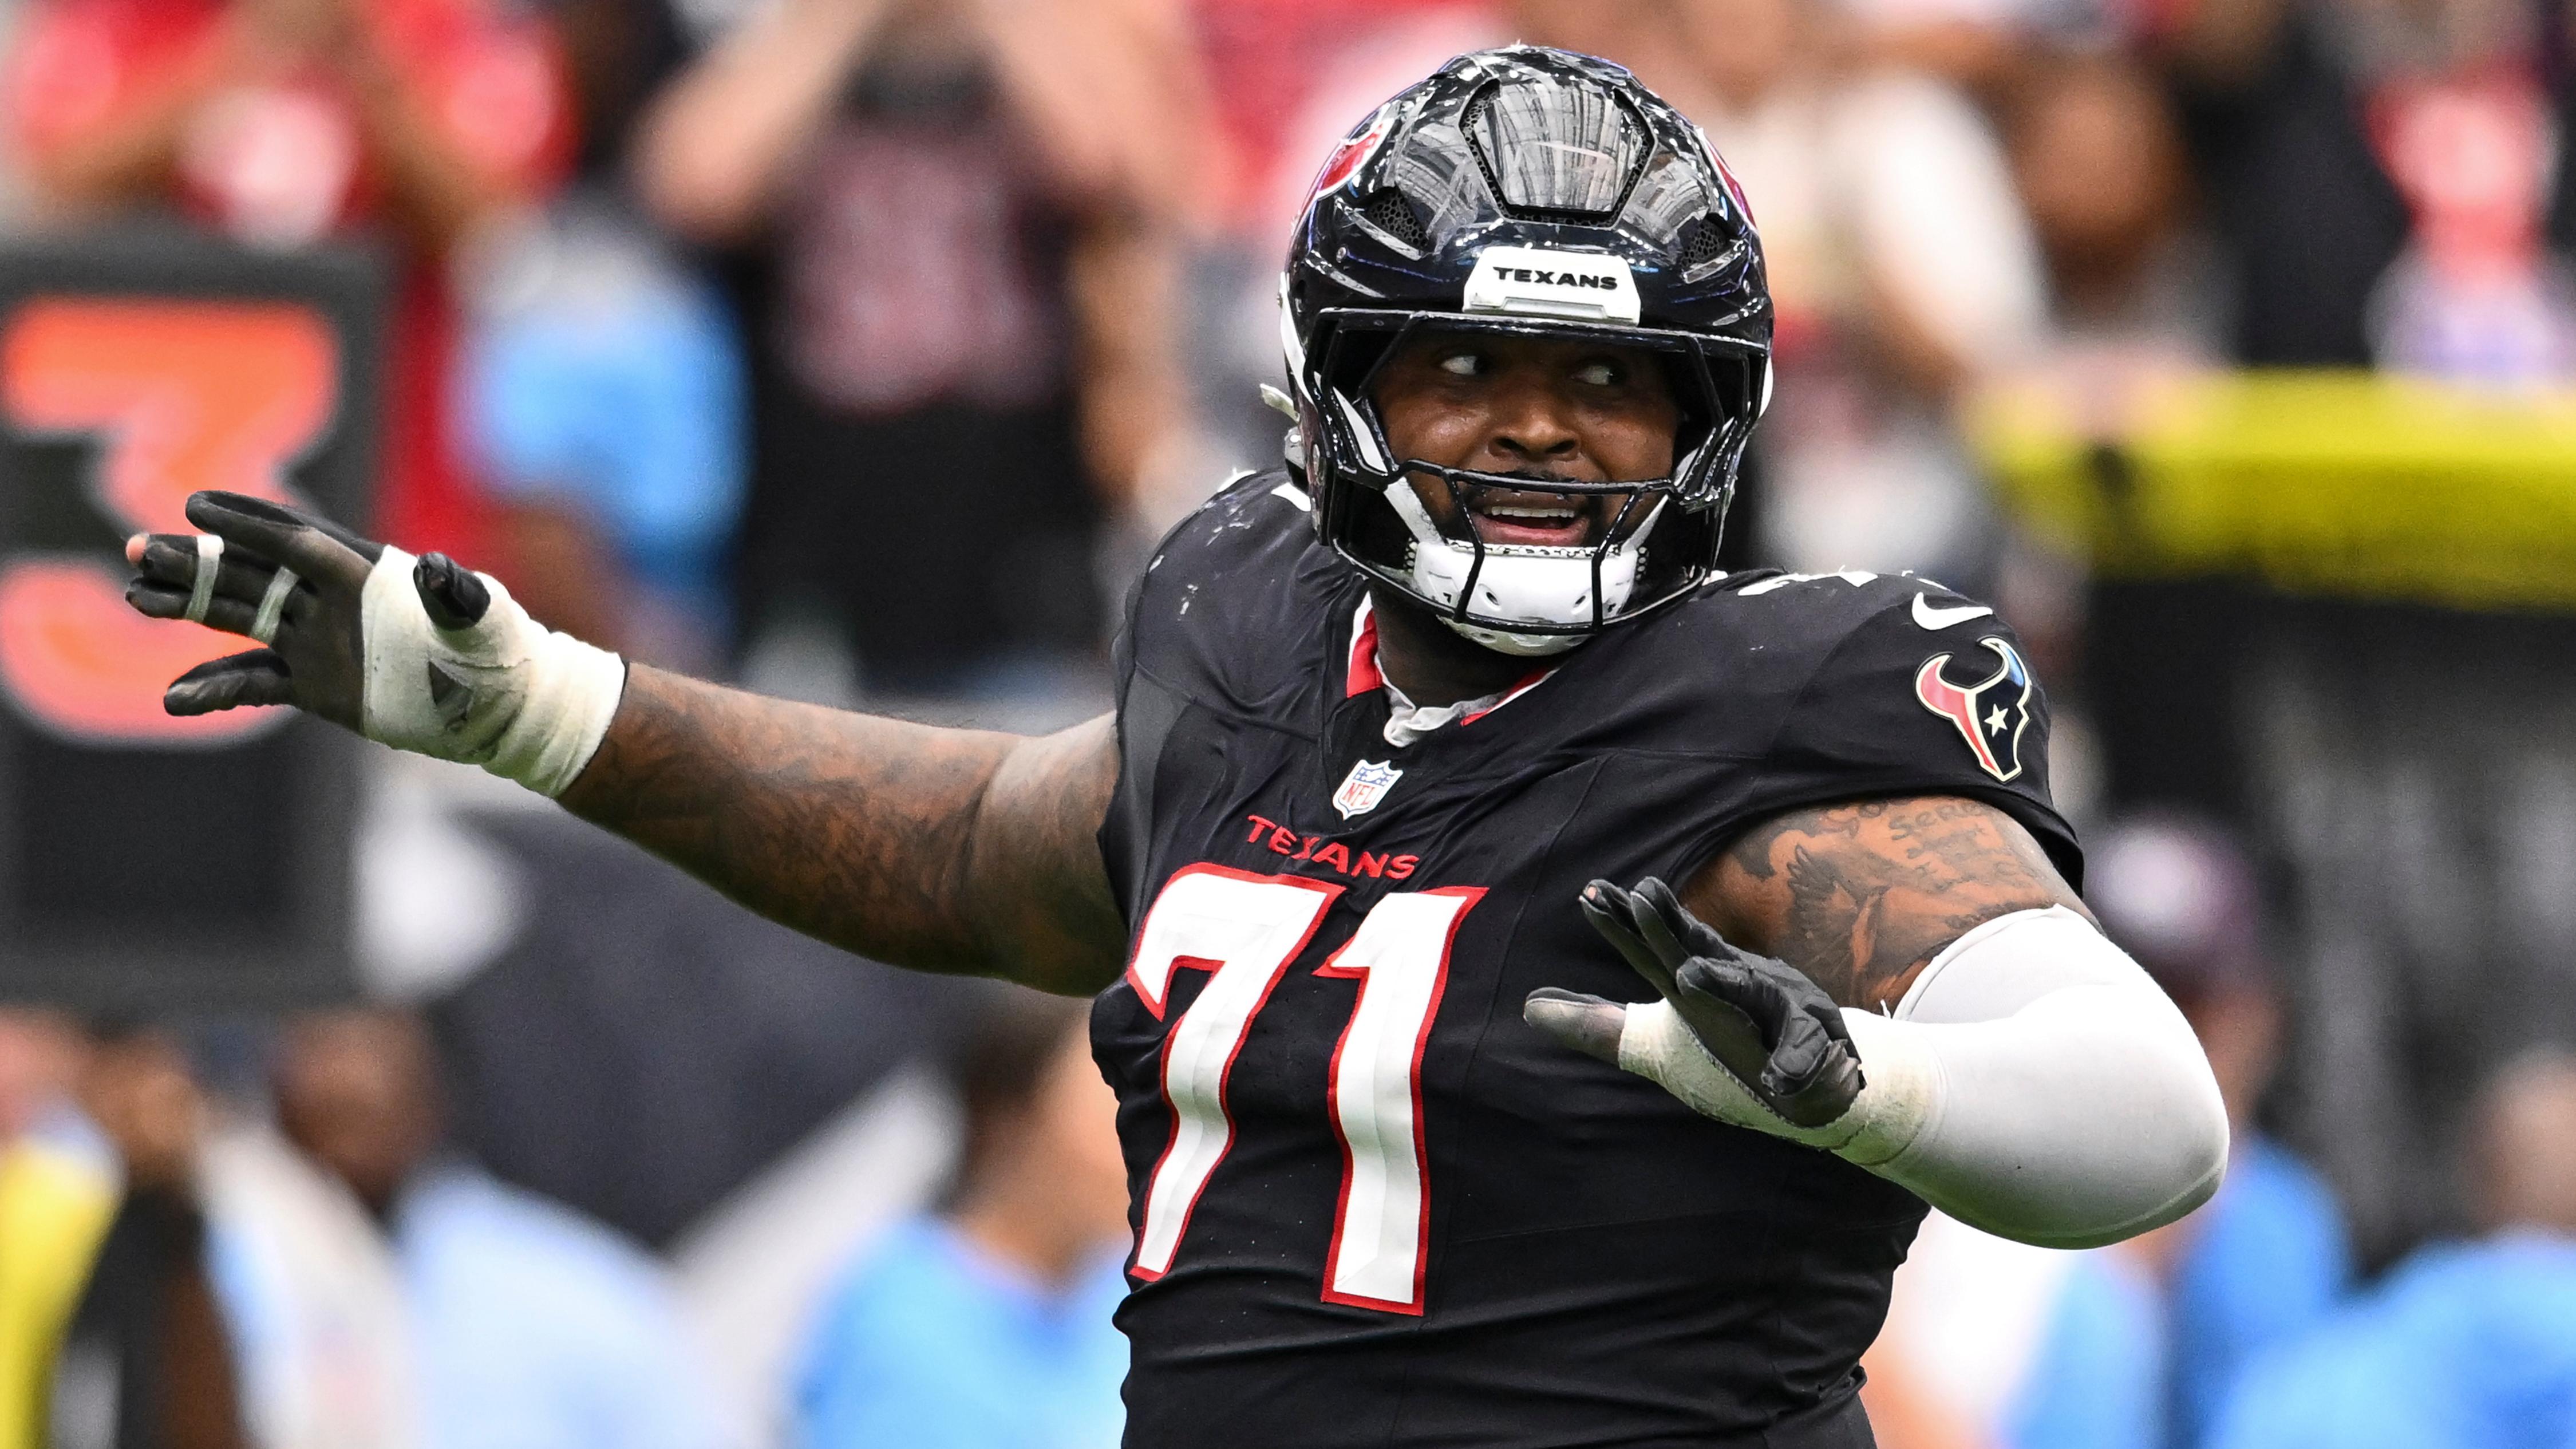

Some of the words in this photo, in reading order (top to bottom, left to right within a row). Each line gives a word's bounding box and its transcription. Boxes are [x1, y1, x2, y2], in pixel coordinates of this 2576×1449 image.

[1493, 267, 1618, 290] TEXANS
[1, 293, 343, 745] 3
[1342, 782, 1376, 807] NFL
[1247, 815, 1420, 880] TEXANS
[1125, 862, 1490, 1317] 71
